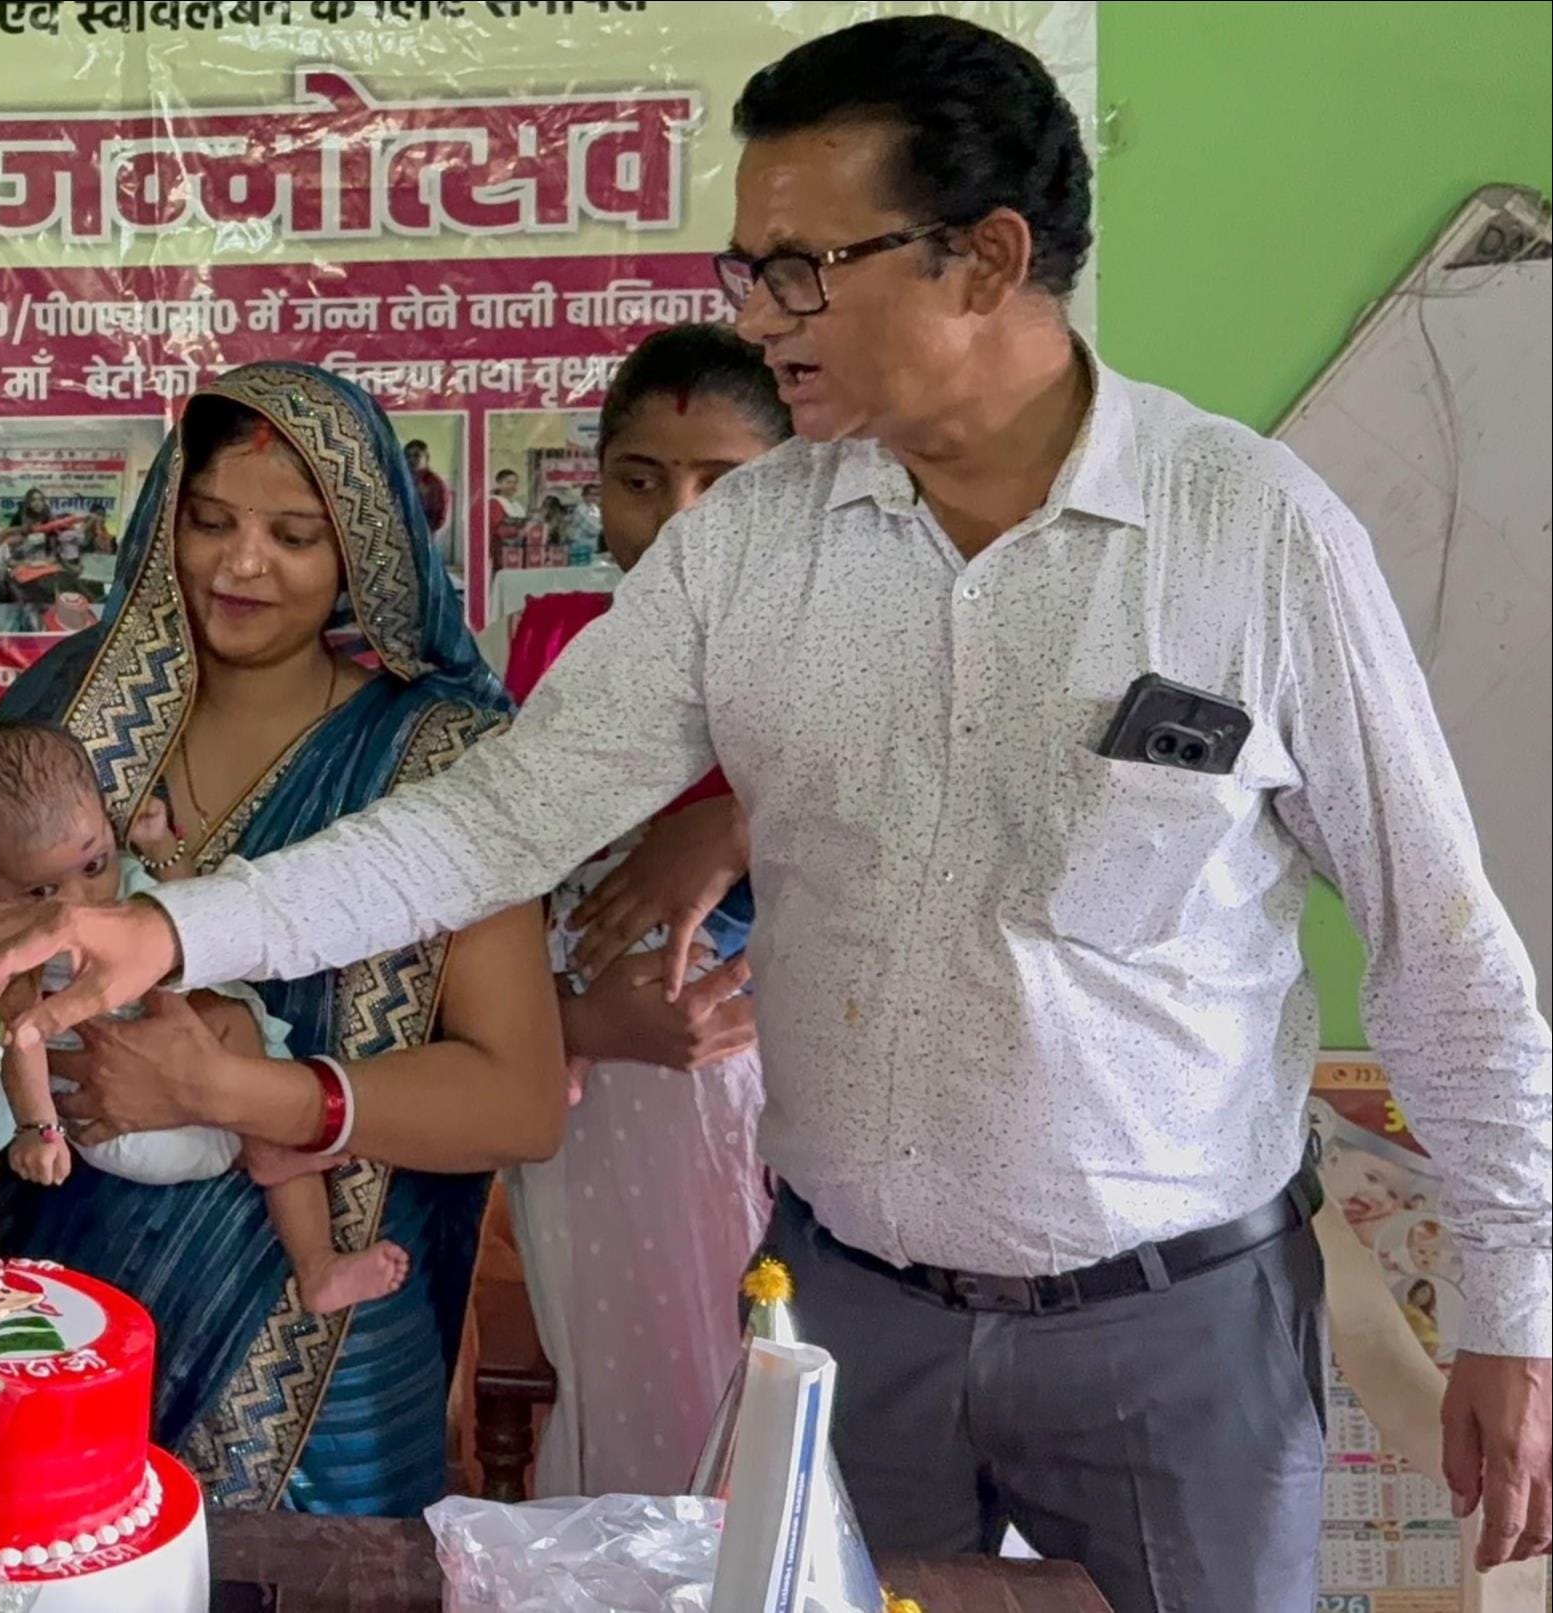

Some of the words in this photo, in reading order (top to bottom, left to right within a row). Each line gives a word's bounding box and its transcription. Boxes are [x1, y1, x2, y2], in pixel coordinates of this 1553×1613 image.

[245, 288, 288, 333] में
[290, 298, 380, 333] जन्म
[387, 284, 461, 330] लेने
[467, 281, 557, 329] वाली
[82, 353, 145, 399] बेटी
[151, 353, 200, 399] को
[452, 356, 527, 394] तथा
